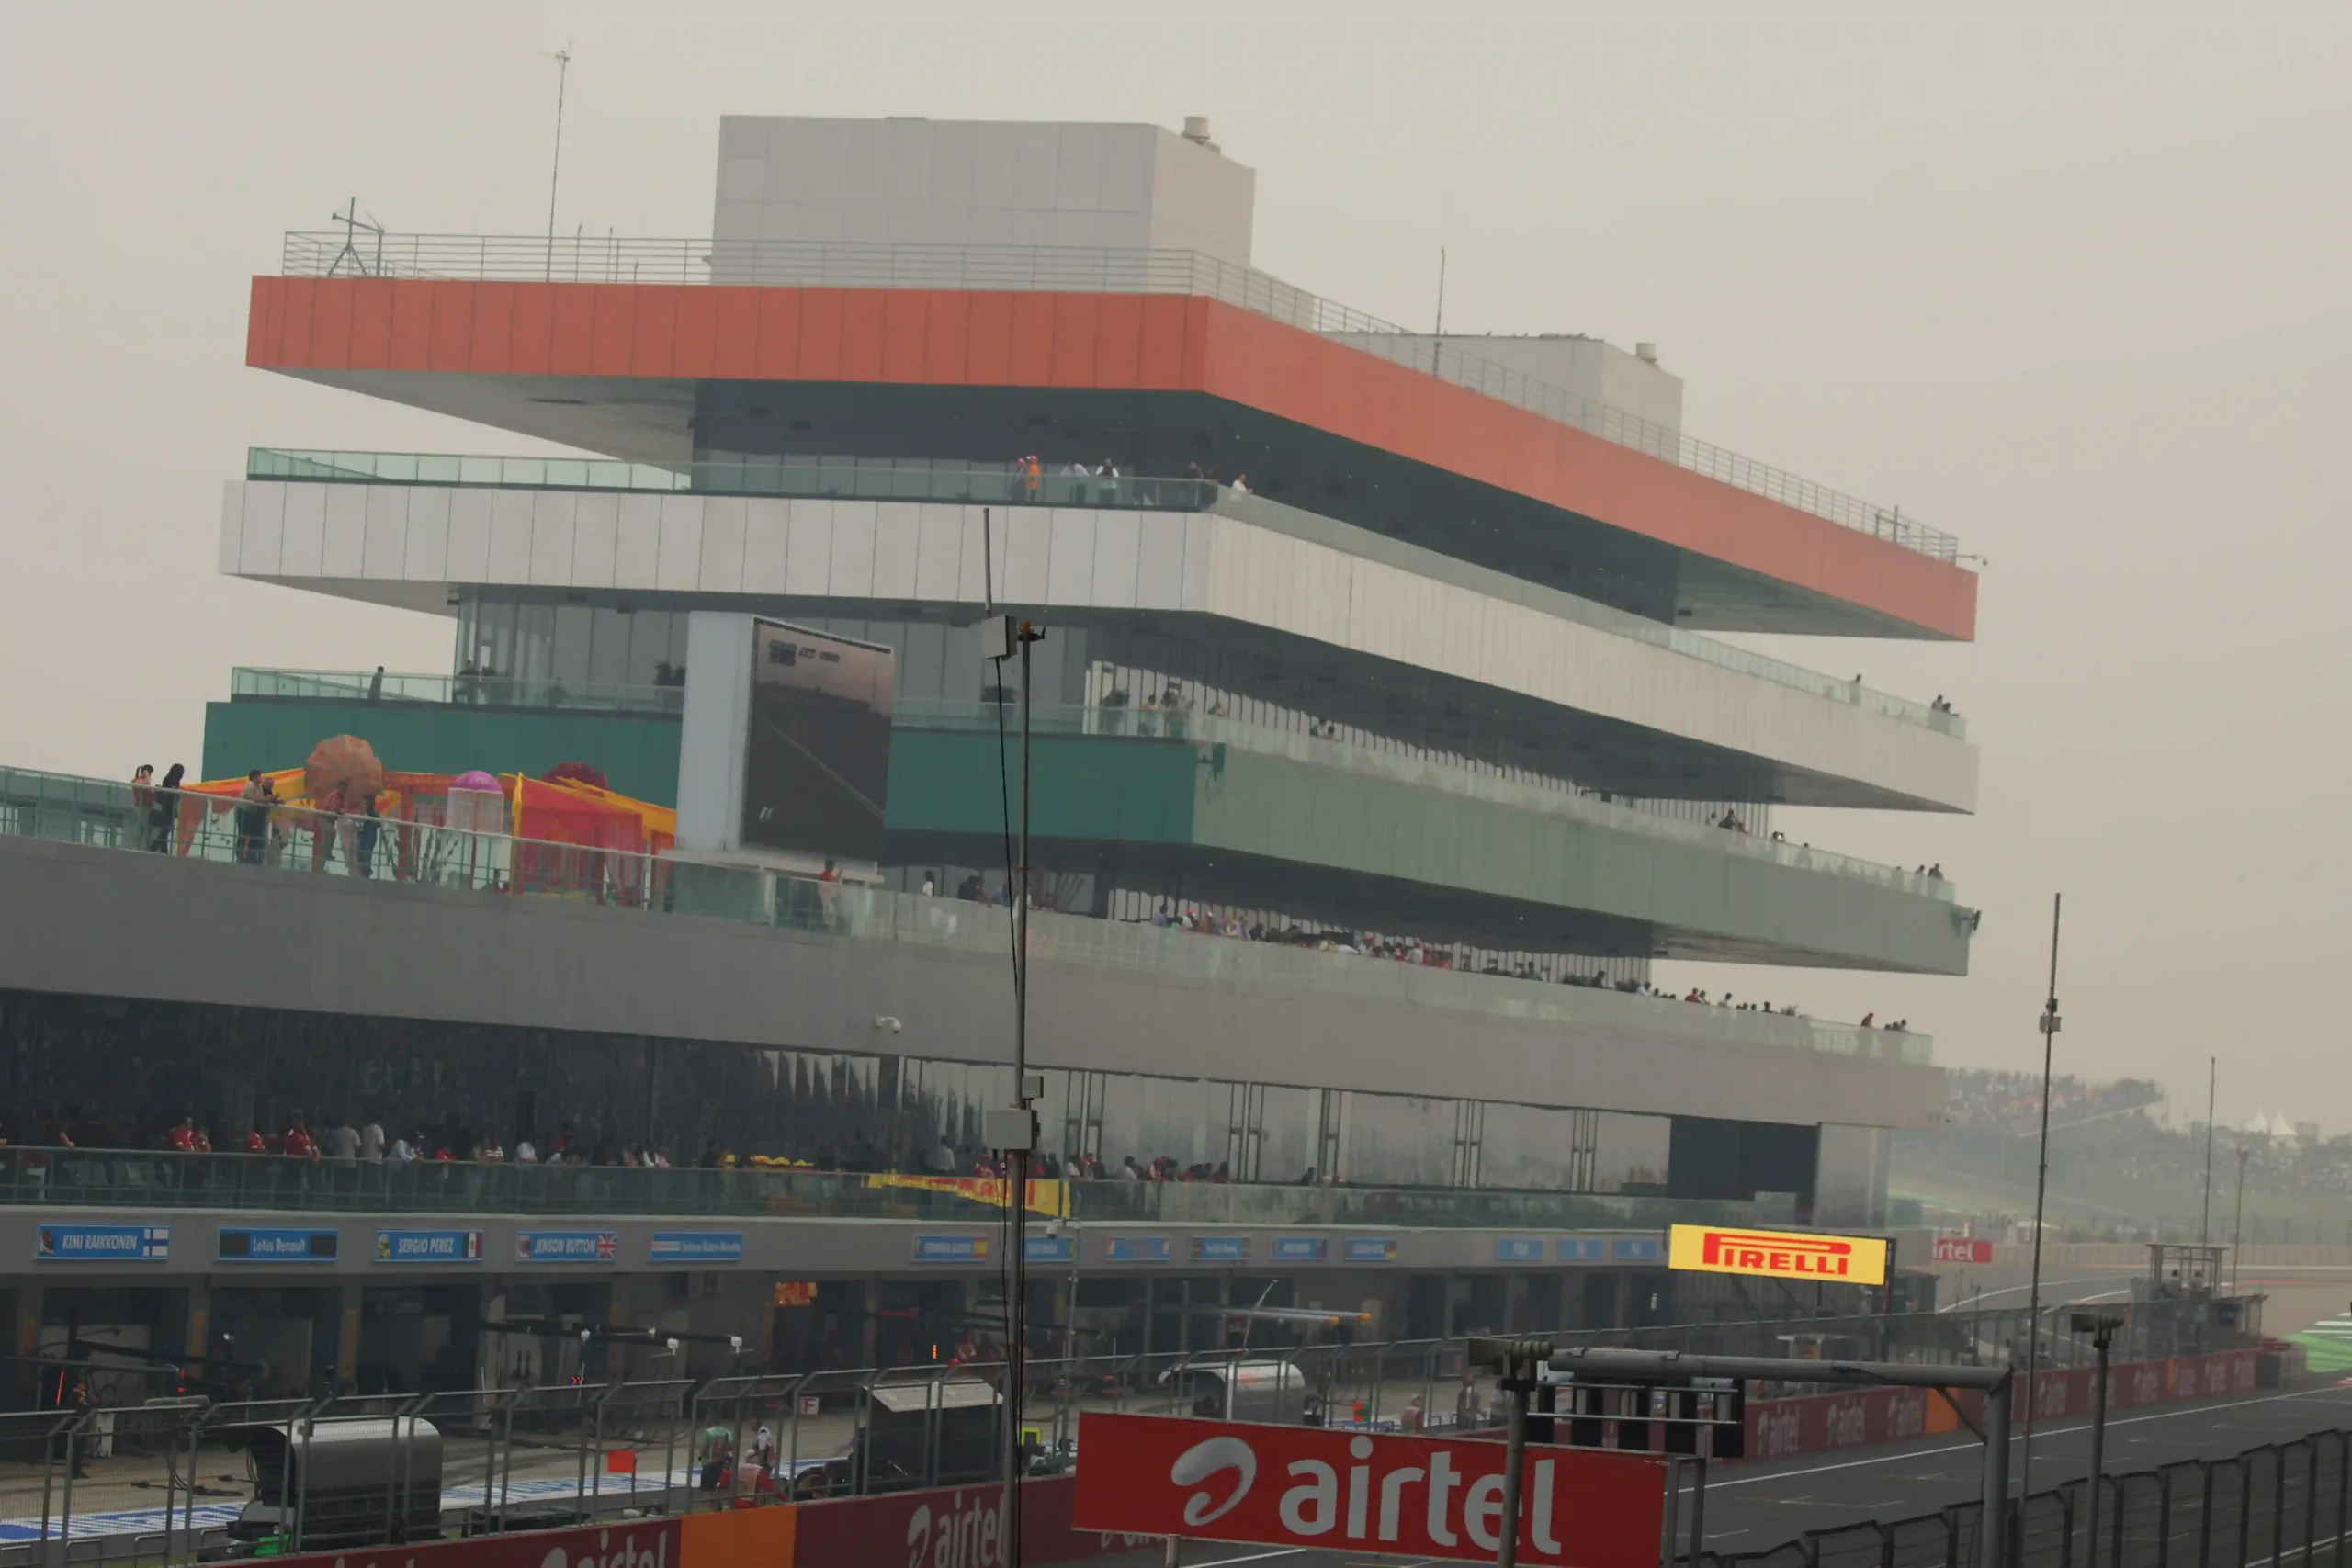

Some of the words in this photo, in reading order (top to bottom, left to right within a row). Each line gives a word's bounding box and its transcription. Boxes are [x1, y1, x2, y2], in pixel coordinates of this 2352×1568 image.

[62, 1234, 84, 1250] KIMI
[253, 1237, 274, 1252] Lotus
[398, 1237, 428, 1254] SERGIO
[430, 1237, 455, 1254] PEREZ
[1702, 1233, 1851, 1275] PIRELLI
[804, 1397, 816, 1414] F
[1279, 1435, 1562, 1556] airtel
